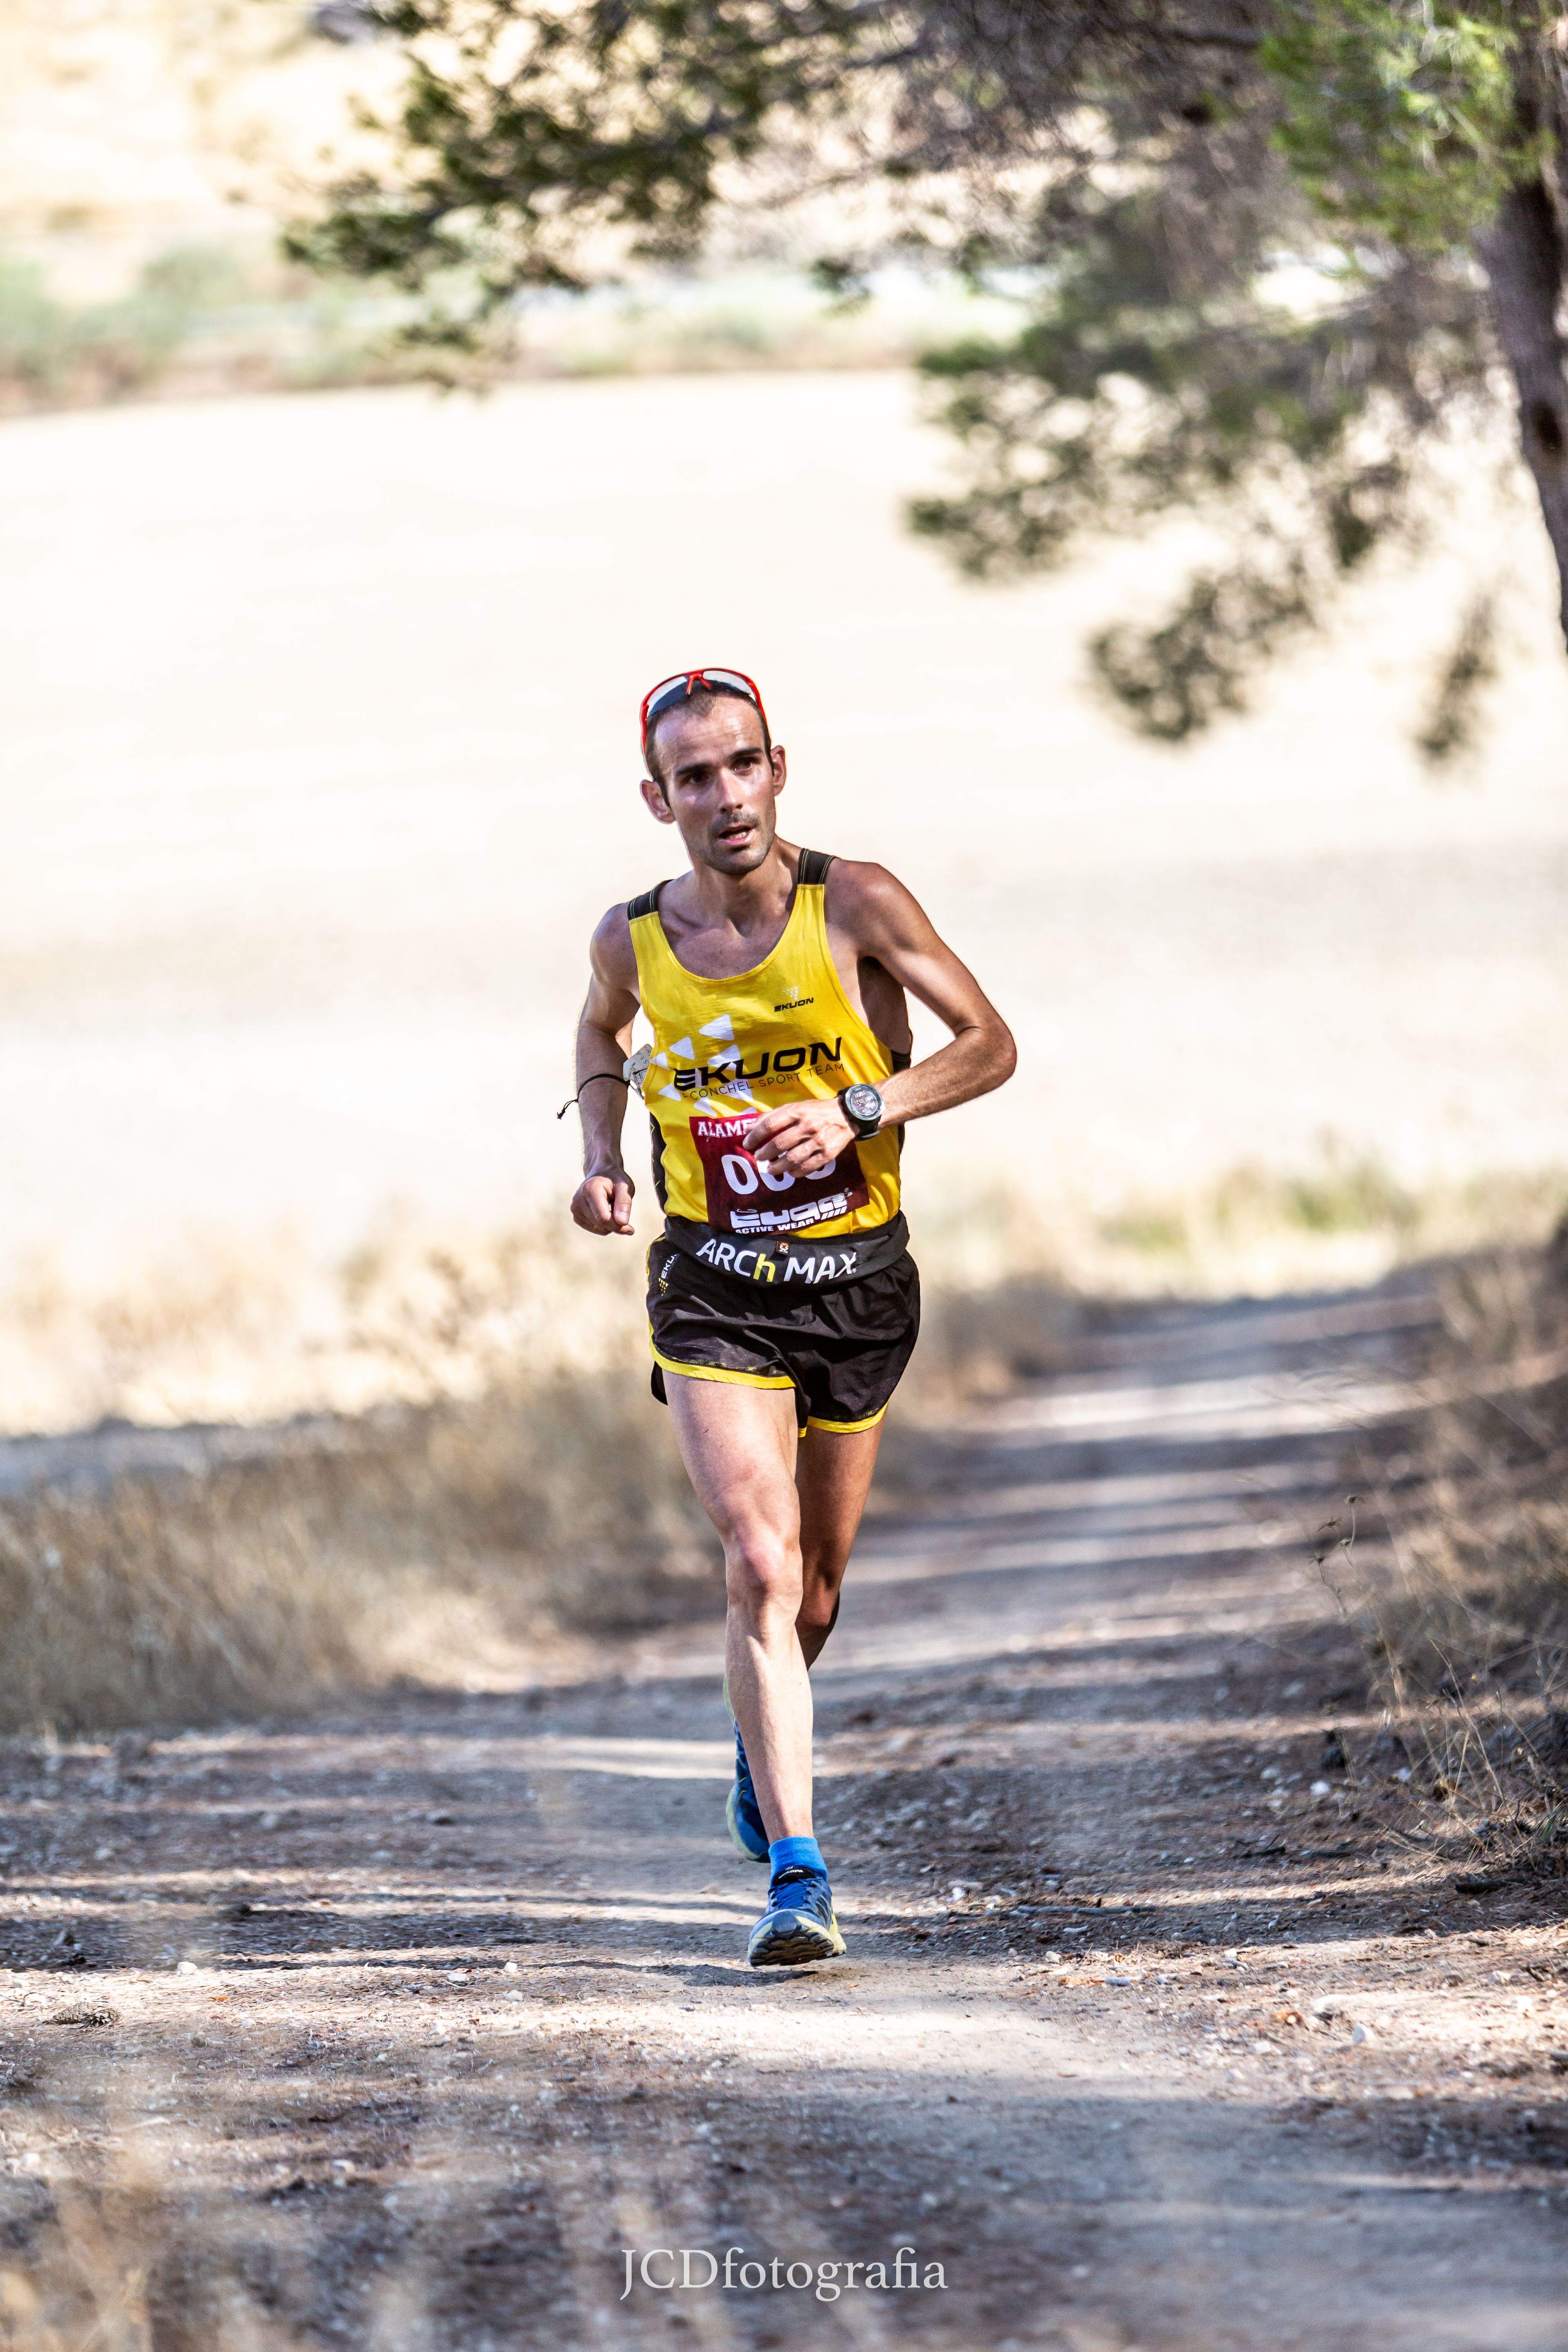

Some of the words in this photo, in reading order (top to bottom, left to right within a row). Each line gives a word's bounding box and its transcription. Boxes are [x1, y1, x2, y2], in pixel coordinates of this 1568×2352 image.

[774, 998, 814, 1012] EKUON
[674, 1037, 842, 1091] EKUON
[690, 1081, 753, 1100] CONCHEL
[758, 1072, 800, 1087] SPORT
[806, 1063, 844, 1077] TEAM
[735, 1226, 774, 1234] ACTIVE
[777, 1218, 814, 1231] WEAR
[696, 1238, 776, 1282] ARCh
